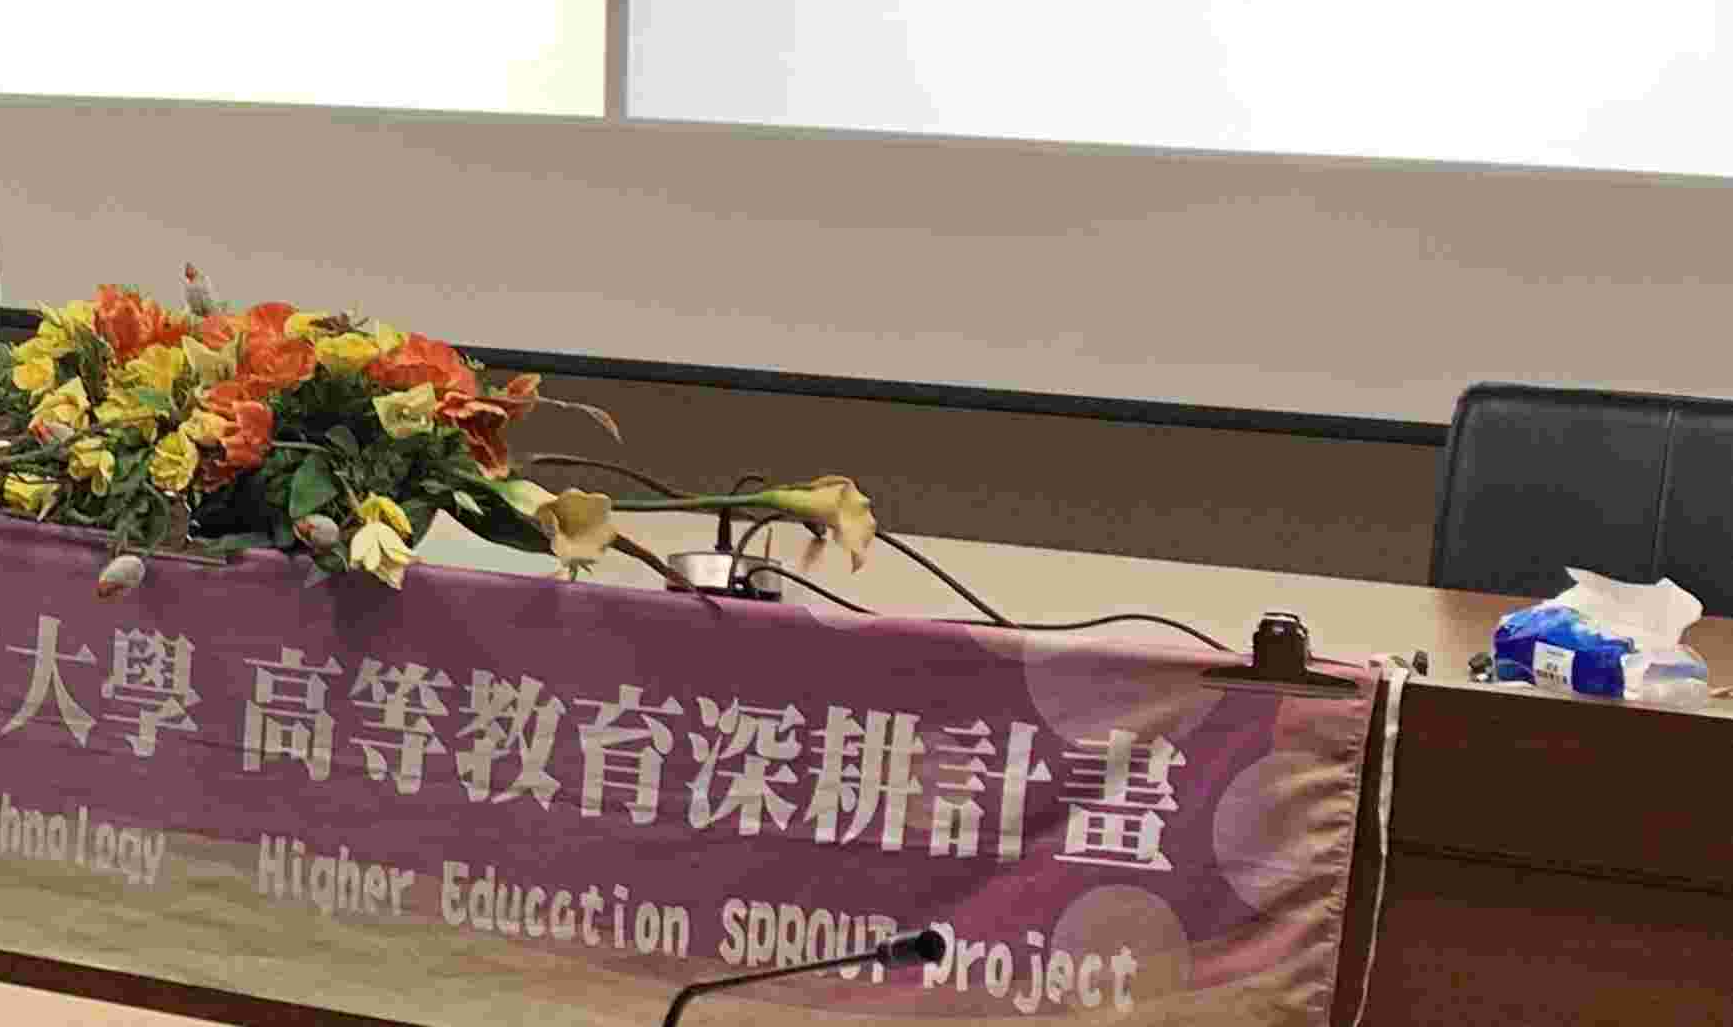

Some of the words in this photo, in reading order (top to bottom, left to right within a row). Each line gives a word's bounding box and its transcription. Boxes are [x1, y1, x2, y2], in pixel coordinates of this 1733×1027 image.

[242, 647, 1187, 870] 高等教育深耕計畫
[257, 833, 415, 916] Higher
[440, 859, 690, 958] Education
[718, 897, 898, 984] SPROUT
